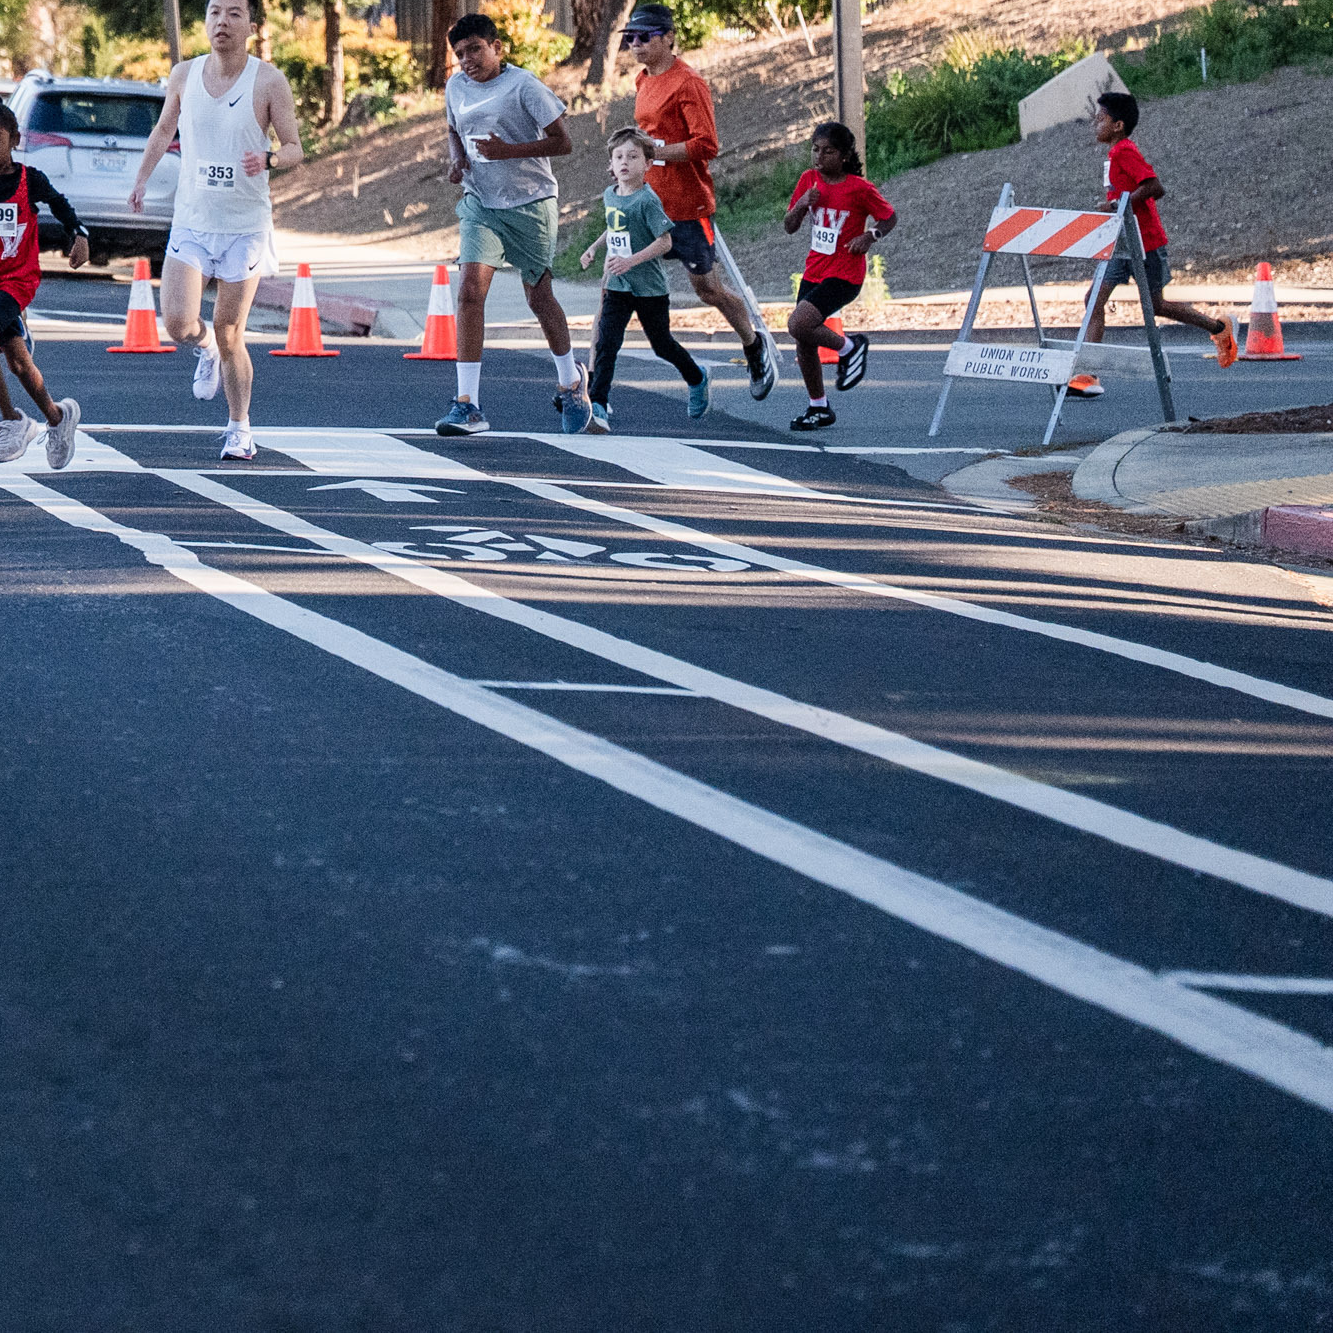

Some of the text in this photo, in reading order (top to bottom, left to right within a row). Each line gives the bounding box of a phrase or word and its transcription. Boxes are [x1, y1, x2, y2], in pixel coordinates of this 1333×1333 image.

[208, 165, 234, 180] 353
[610, 235, 628, 247] 491
[815, 230, 835, 244] 493
[980, 347, 1044, 363] UNION CITY
[964, 361, 1050, 380] PUBLIC WORKS
